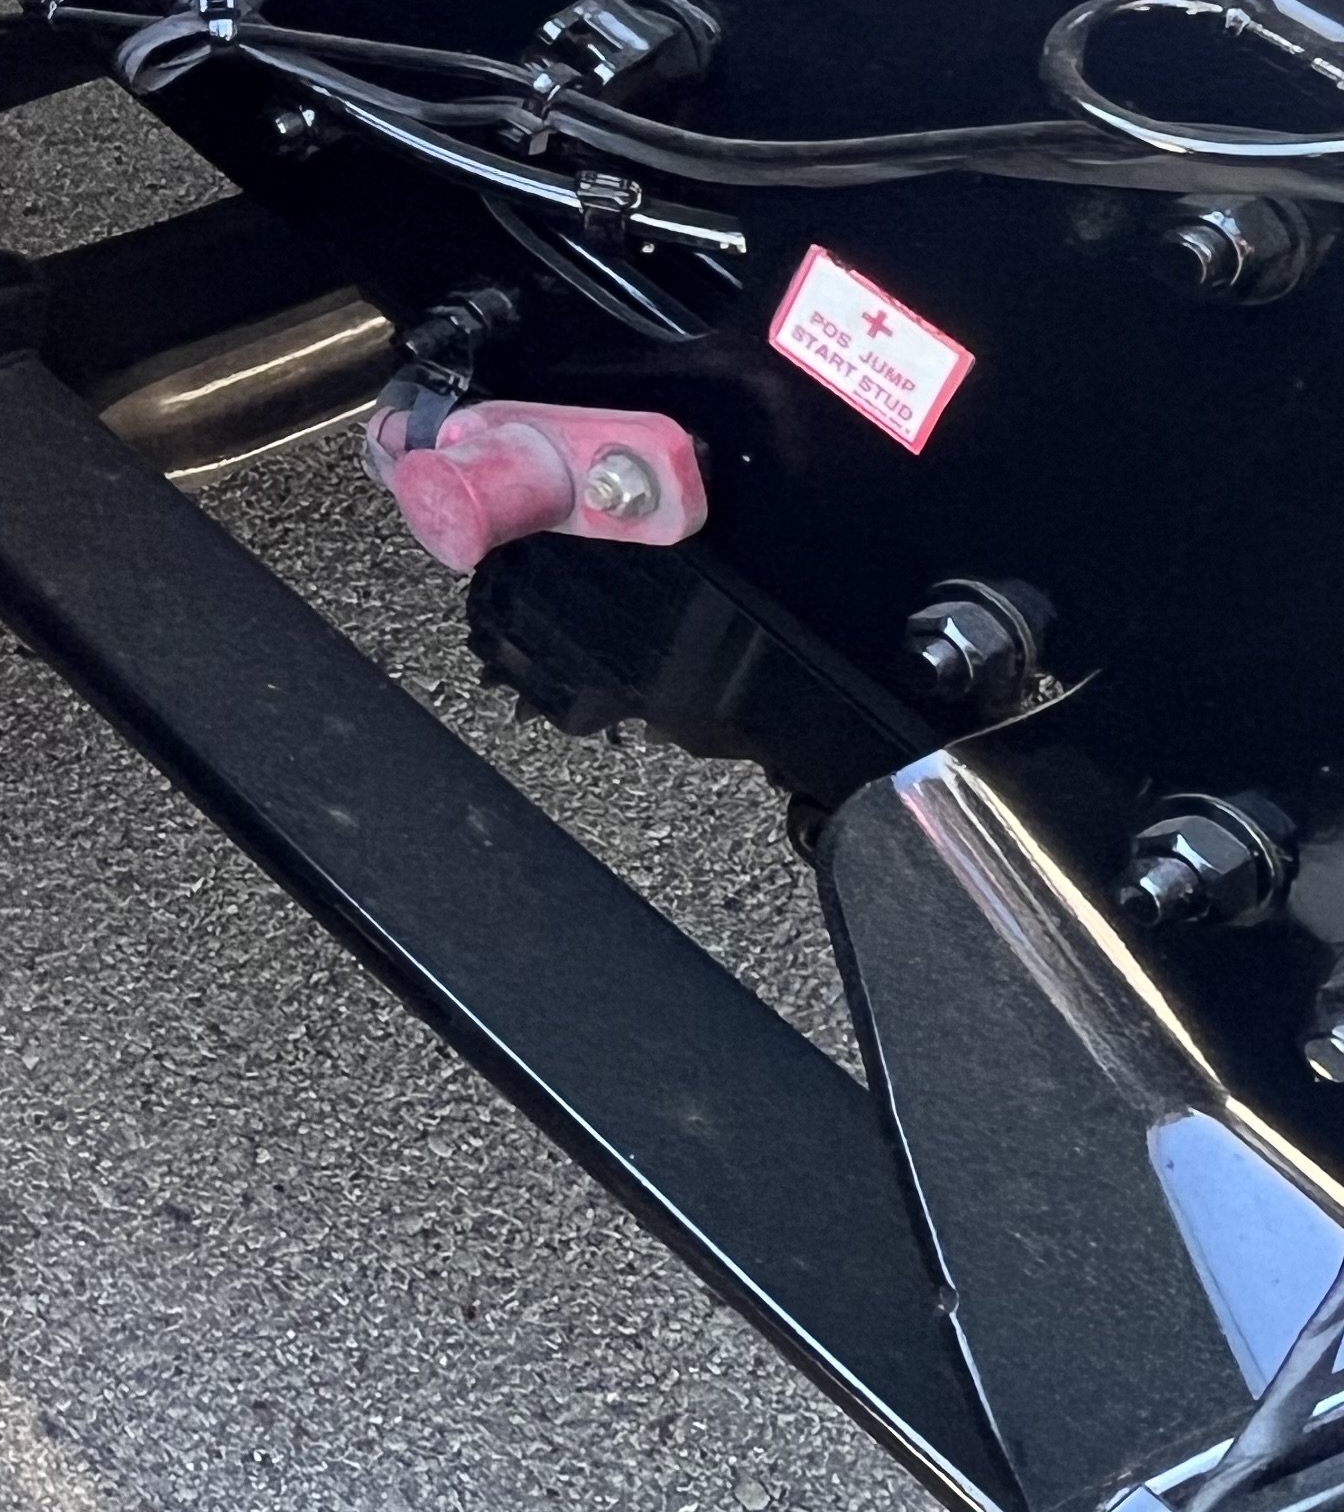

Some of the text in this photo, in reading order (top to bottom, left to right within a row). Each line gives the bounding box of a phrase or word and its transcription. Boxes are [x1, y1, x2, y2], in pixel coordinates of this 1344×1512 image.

[792, 325, 858, 377] START
[858, 375, 913, 421] STUD
[810, 311, 916, 392] POS JUMP
